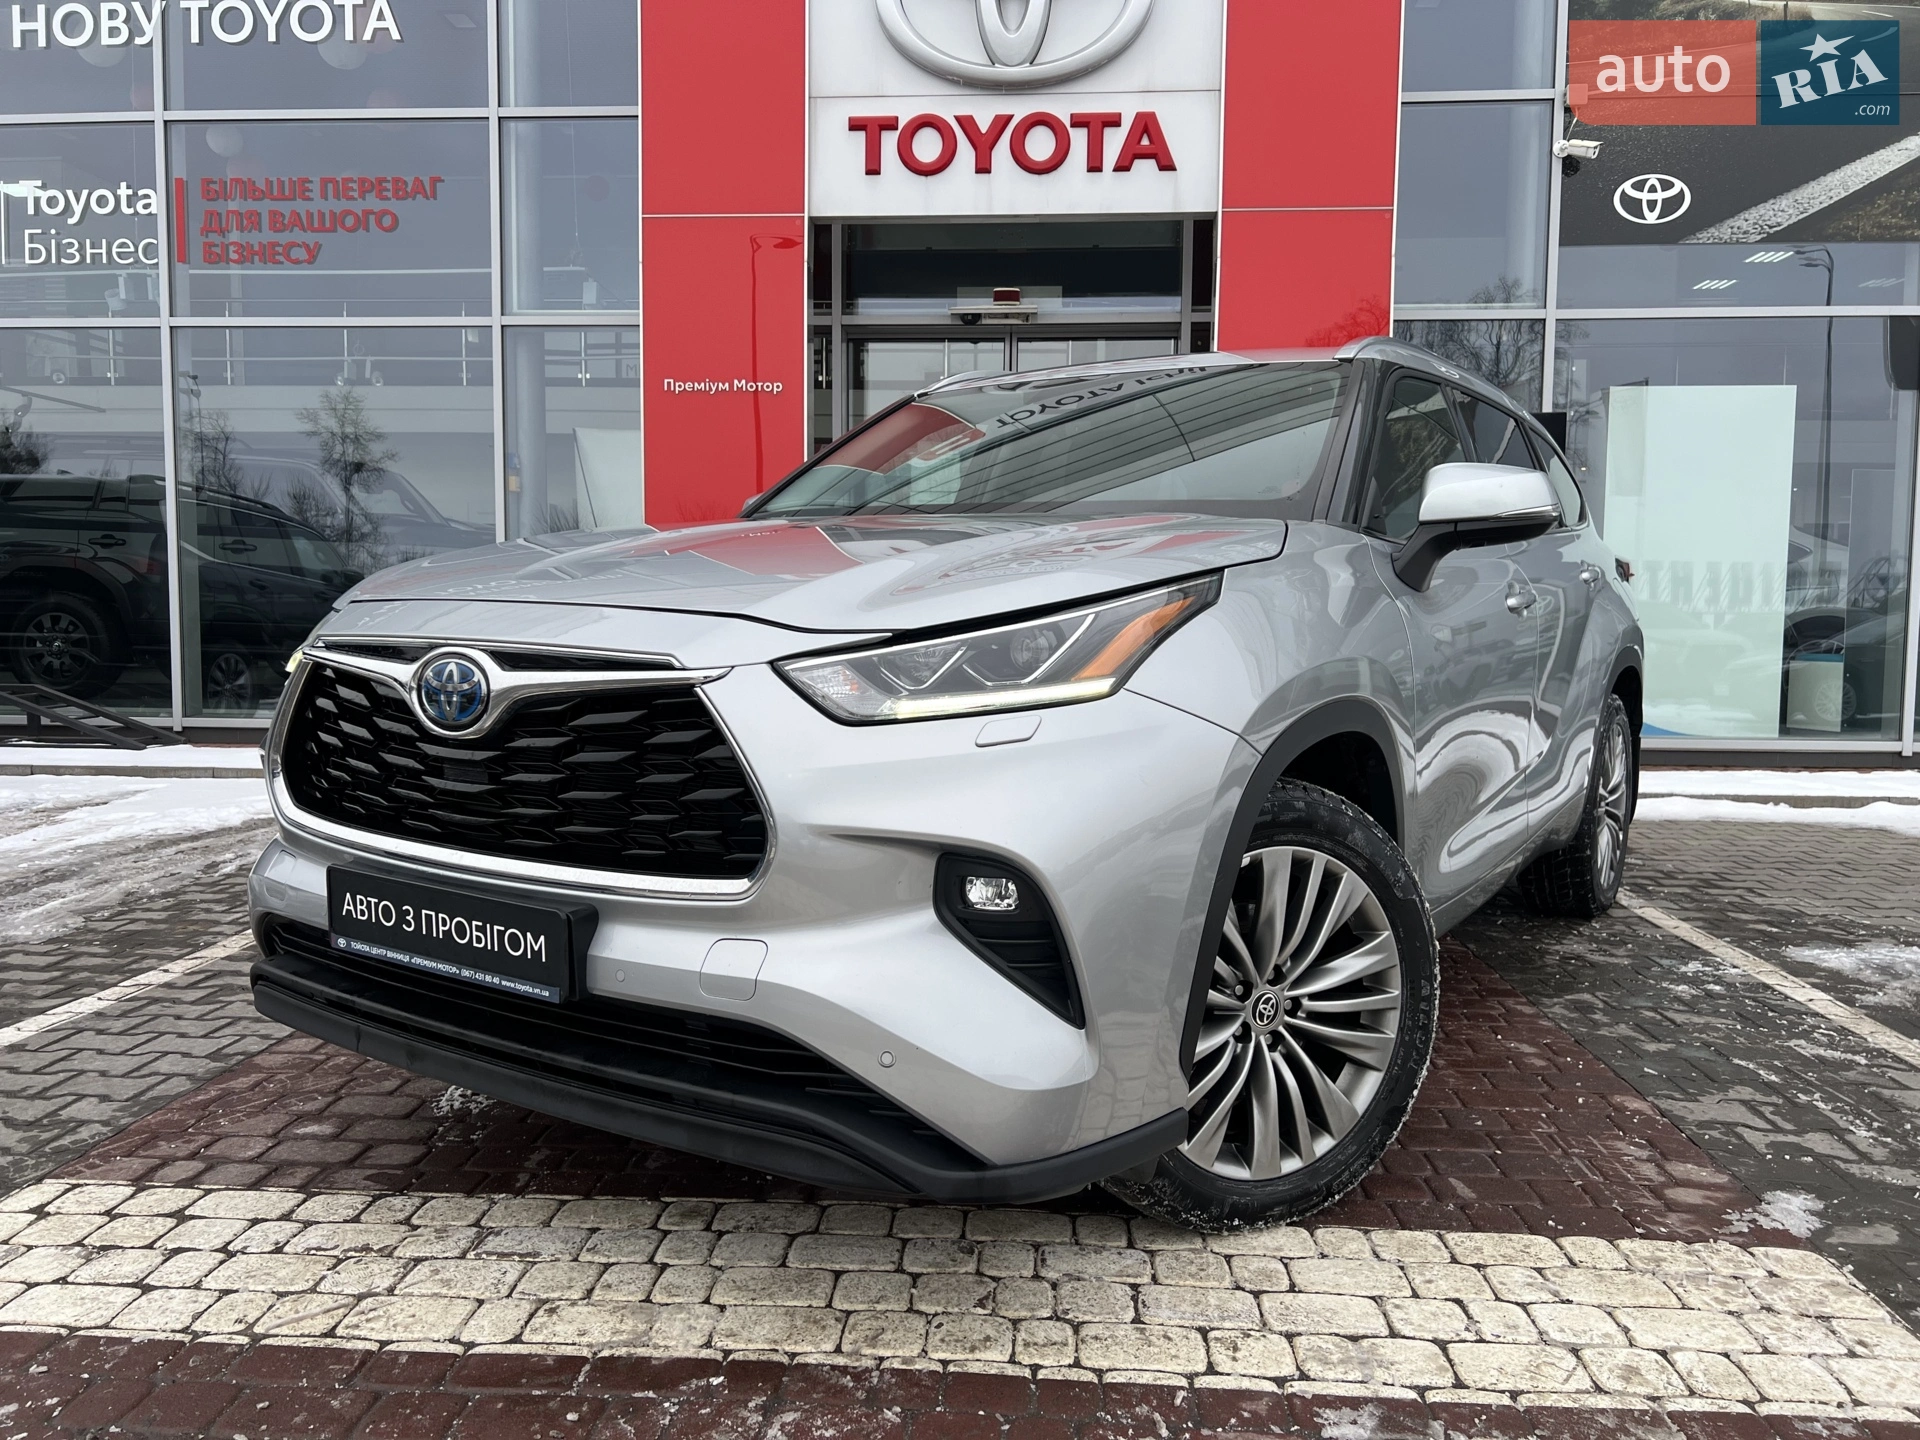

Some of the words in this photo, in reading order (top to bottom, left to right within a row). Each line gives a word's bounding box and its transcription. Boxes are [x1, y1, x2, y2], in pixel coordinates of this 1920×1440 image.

[11, 1, 167, 48] НОВУ
[180, 0, 402, 44] TOYOTA
[848, 111, 1178, 176] TOYOTA
[18, 180, 157, 225] Toyota
[200, 176, 313, 201] БІЛЬШЕ
[319, 175, 444, 201] ПЕРЕВАГ
[199, 208, 261, 237] ДЛЯ
[267, 208, 399, 233] ВАШОГО
[24, 228, 159, 264] Бізнес
[202, 240, 321, 265] БІЗНЕСУ
[663, 378, 730, 395] Преміум
[733, 378, 783, 395] Мотор
[342, 892, 396, 928] АВТО
[421, 908, 546, 963] ПРОБІГОМ
[370, 946, 386, 956] ЦЕНТР
[475, 972, 485, 981] 431
[500, 979, 550, 997] www.toyota.vn.ua
